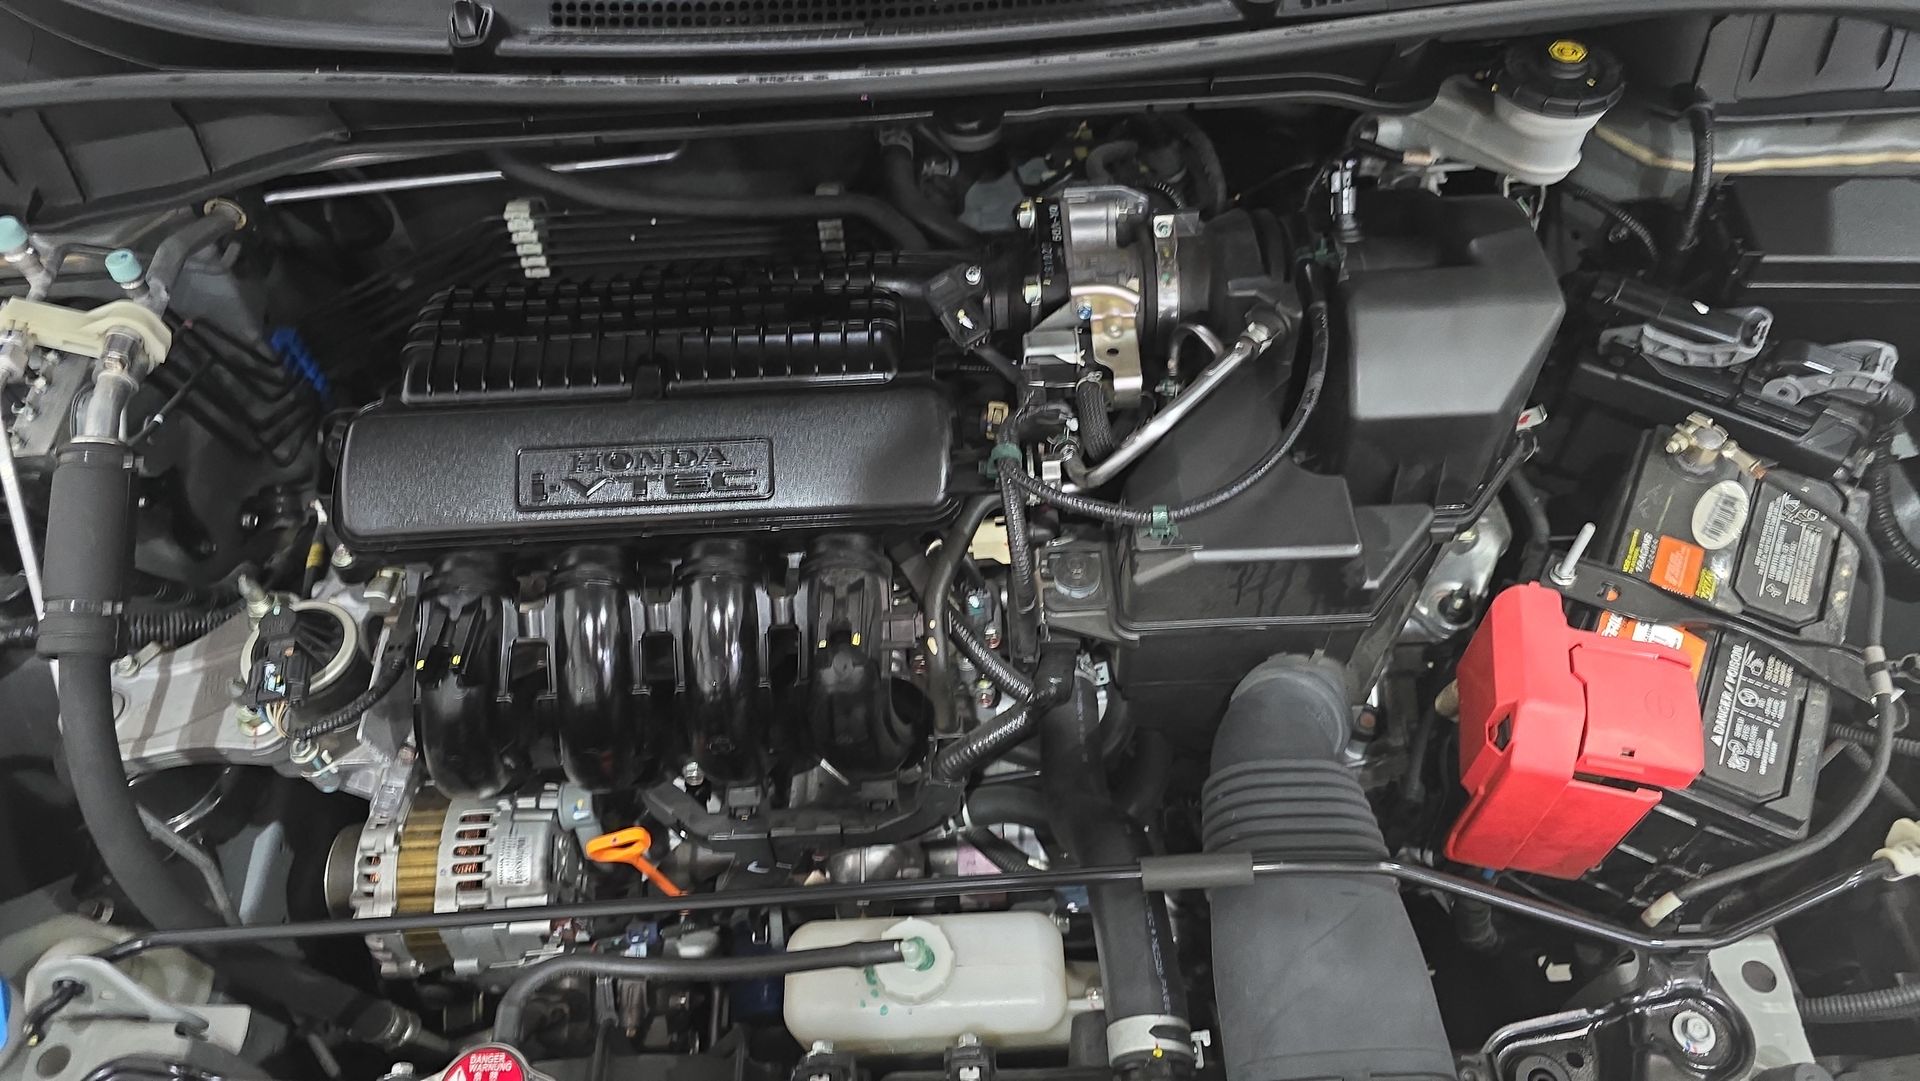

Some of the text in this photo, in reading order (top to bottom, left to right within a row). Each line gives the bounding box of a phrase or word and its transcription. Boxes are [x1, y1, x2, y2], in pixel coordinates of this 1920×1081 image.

[570, 447, 732, 473] HONDA
[531, 469, 757, 503] i-VTEC
[469, 1061, 512, 1072] WARNUNG
[470, 1053, 506, 1064] DANGER
